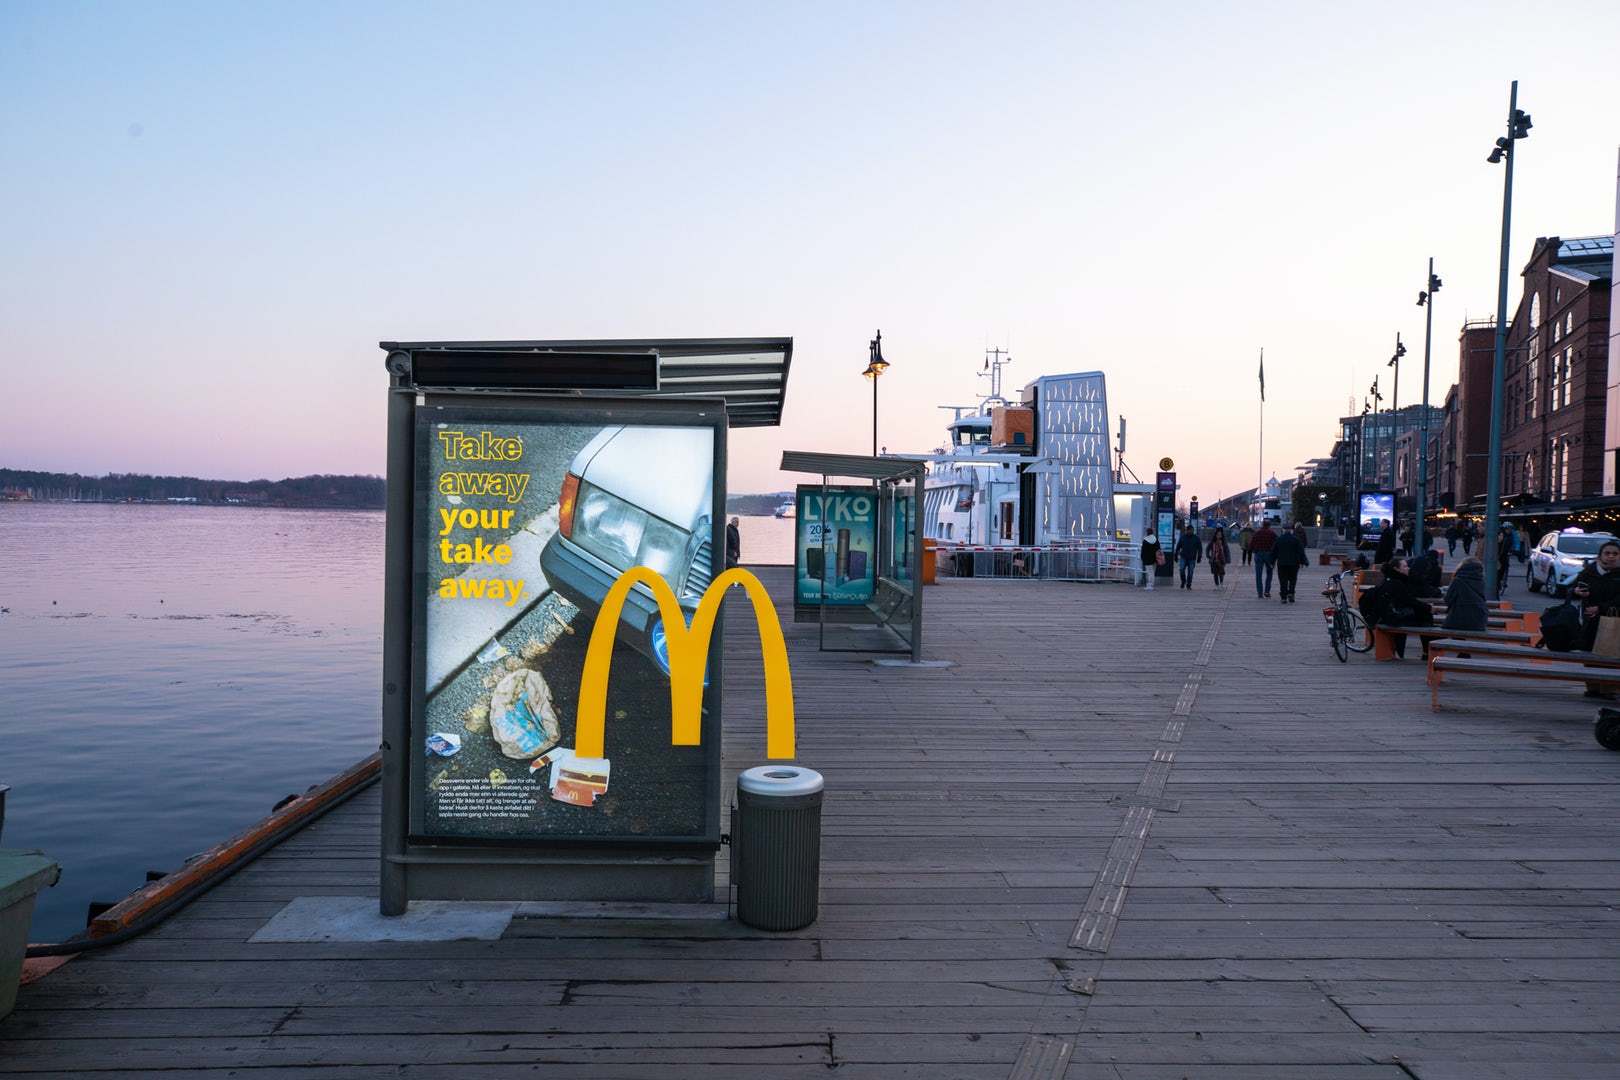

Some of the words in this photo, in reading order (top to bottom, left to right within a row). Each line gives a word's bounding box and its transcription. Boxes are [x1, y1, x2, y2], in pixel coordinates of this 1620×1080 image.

[438, 431, 523, 462] Take
[438, 472, 530, 502] away
[438, 506, 515, 536] your
[804, 495, 871, 522] LYKO
[439, 538, 513, 565] take
[438, 577, 529, 607] away.
